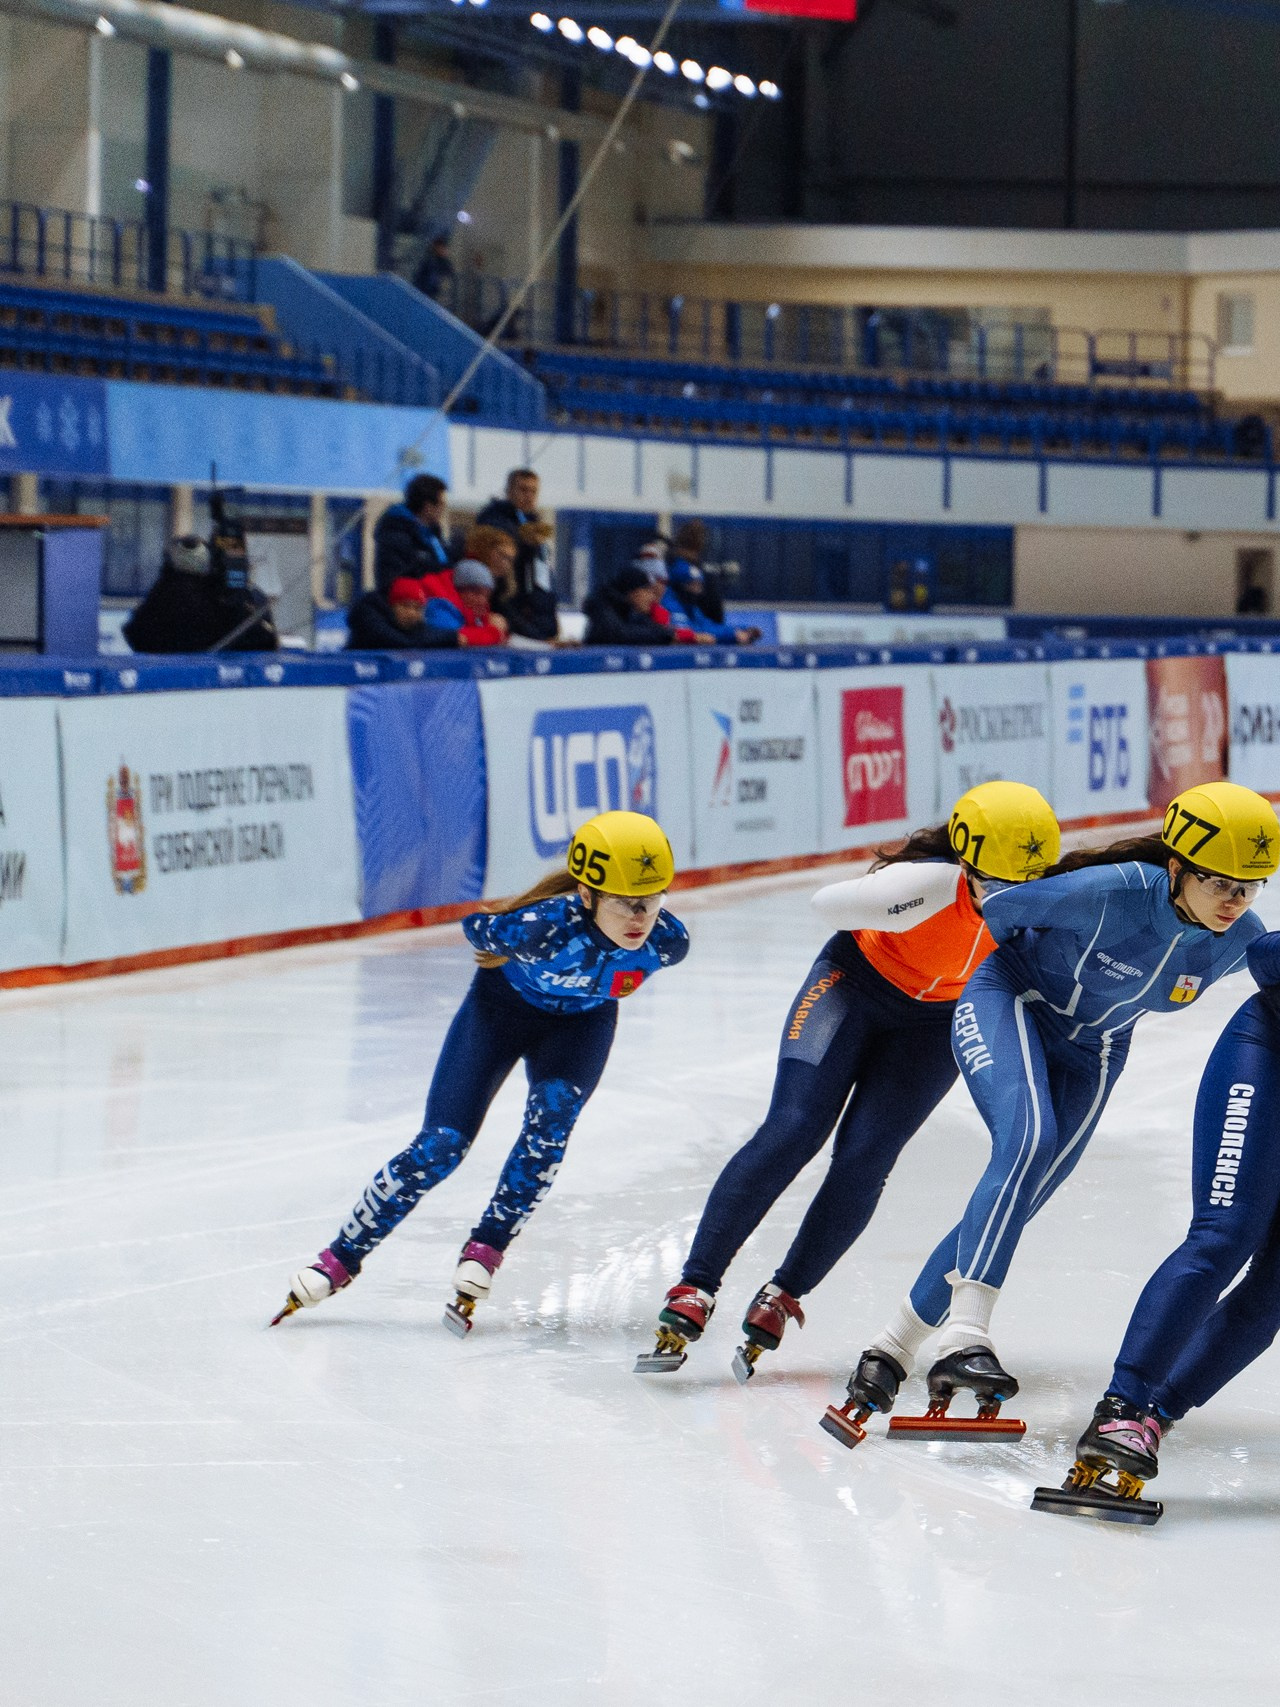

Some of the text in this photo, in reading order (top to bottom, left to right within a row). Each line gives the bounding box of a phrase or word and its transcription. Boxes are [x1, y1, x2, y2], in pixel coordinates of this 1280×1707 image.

[1163, 803, 1221, 857] 077
[568, 836, 611, 886] 95
[540, 970, 592, 988] TVER
[955, 1002, 994, 1076] СЕРГАЧ
[1209, 1082, 1255, 1208] СМОЛЕНСК
